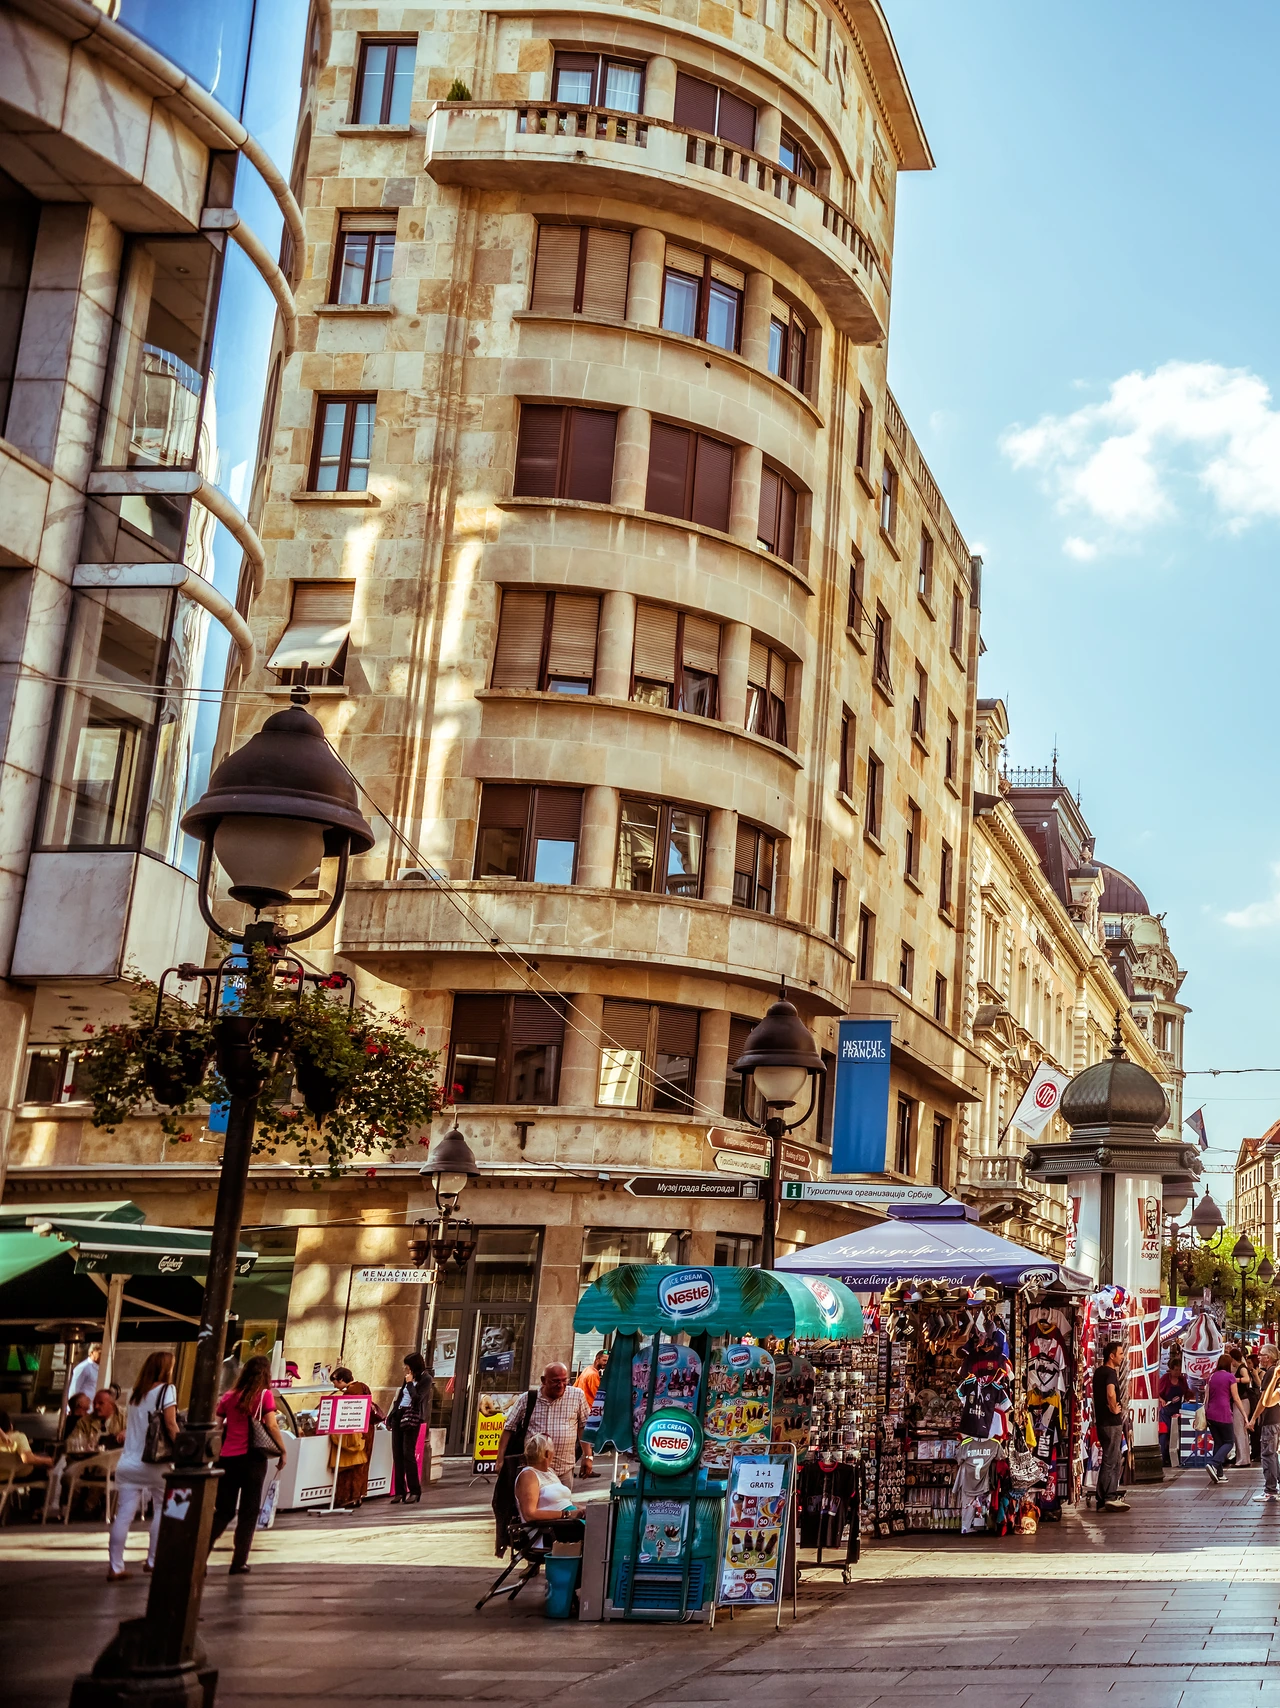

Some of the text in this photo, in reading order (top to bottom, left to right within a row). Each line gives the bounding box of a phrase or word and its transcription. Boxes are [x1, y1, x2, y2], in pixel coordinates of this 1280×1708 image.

[843, 1040, 882, 1050] INSTITUT
[656, 1183, 735, 1194] Музеј града Београда
[806, 1186, 933, 1200] Туристичка организација Србије
[158, 1255, 184, 1271] Carlsberg
[362, 1269, 427, 1278] MENJAČNICA
[668, 1273, 703, 1287] ICE CREAM
[844, 1274, 892, 1285] Excellent
[668, 1424, 687, 1433] CREAM
[972, 1458, 984, 1480] 7
